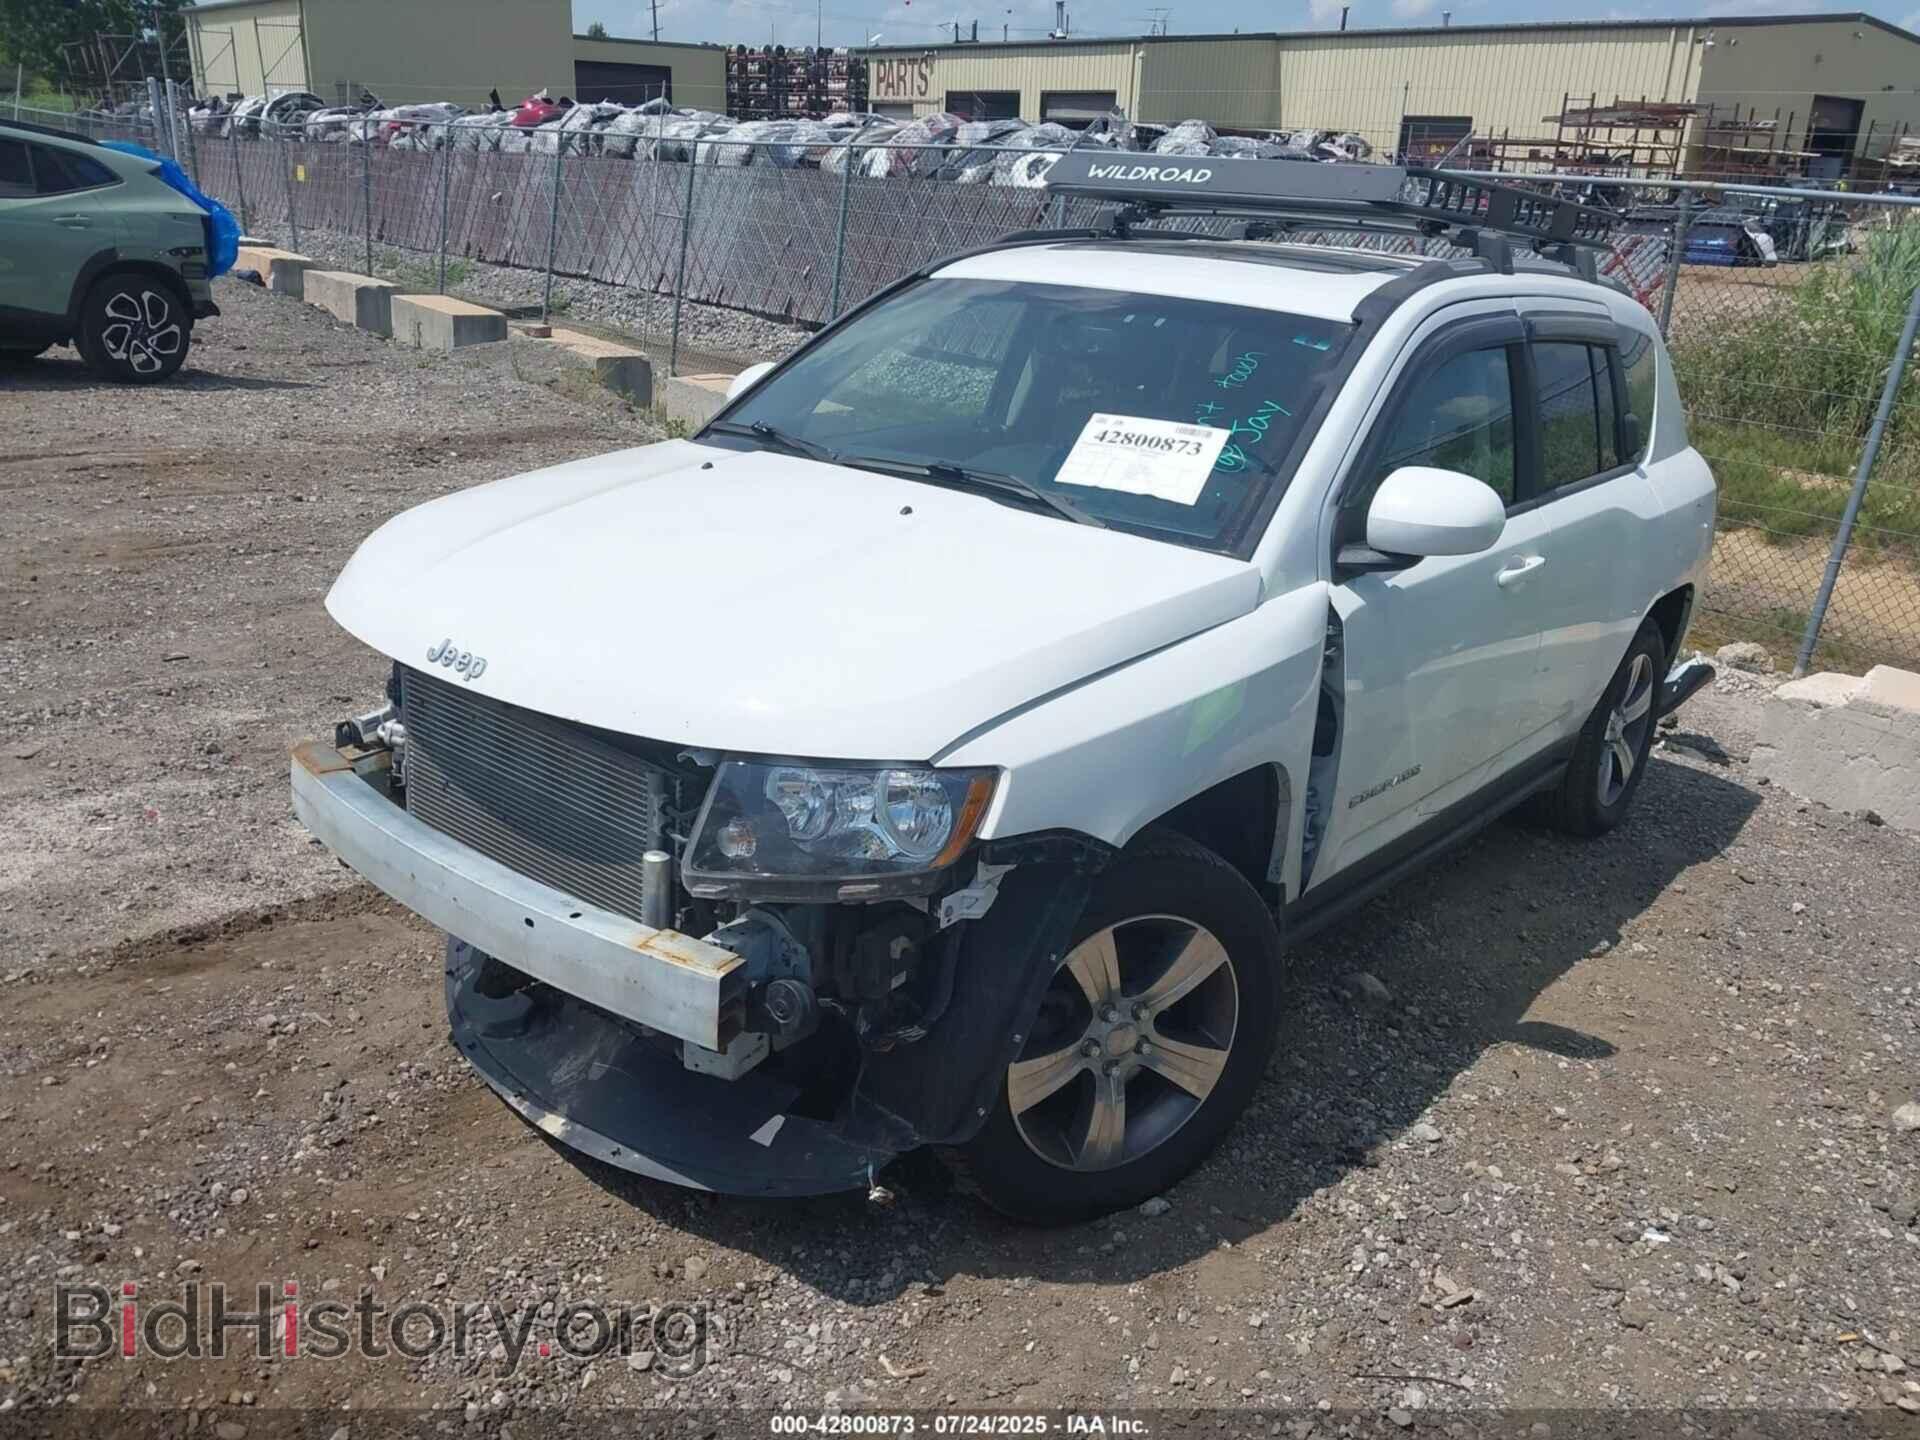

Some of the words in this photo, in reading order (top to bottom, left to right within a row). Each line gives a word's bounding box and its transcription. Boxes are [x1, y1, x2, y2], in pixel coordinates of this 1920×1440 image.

[876, 58, 929, 97] PARTS
[1088, 164, 1212, 183] WILDROAD
[1094, 429, 1203, 456] 42800873
[426, 638, 489, 682] Jeep
